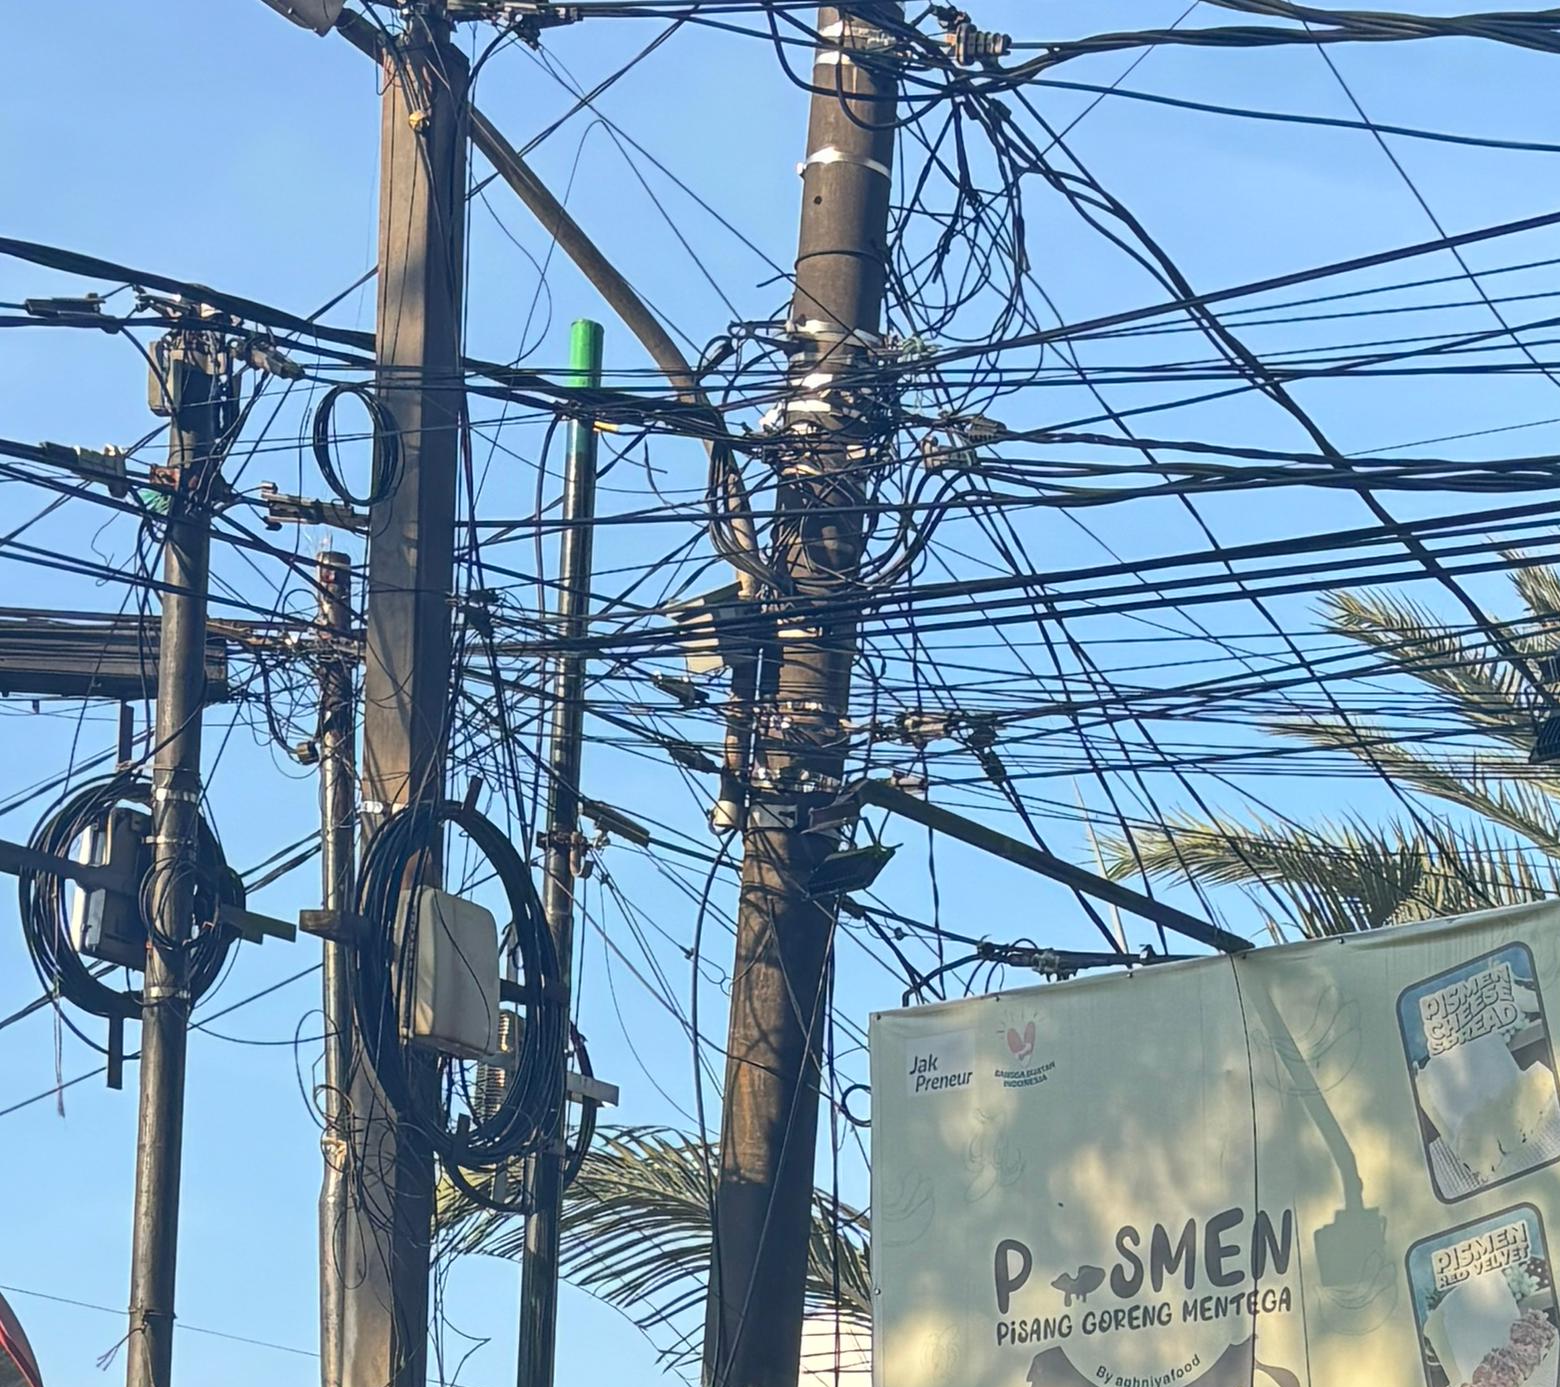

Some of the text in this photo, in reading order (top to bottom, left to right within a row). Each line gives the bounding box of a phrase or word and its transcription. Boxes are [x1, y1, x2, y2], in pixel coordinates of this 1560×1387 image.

[1424, 964, 1512, 1021] PISMEN
[1430, 983, 1513, 1041] CHEESE
[1431, 1002, 1519, 1056] SPREAD
[909, 1053, 939, 1075] Jak
[915, 1071, 973, 1092] Preneur
[994, 1207, 1292, 1315] PSMEN
[1435, 1222, 1529, 1275] PISMEN
[1473, 1245, 1531, 1276] VELVET
[1082, 1302, 1173, 1336] GORENG
[1182, 1286, 1291, 1323] MENTEGA
[1096, 1364, 1114, 1385] By
